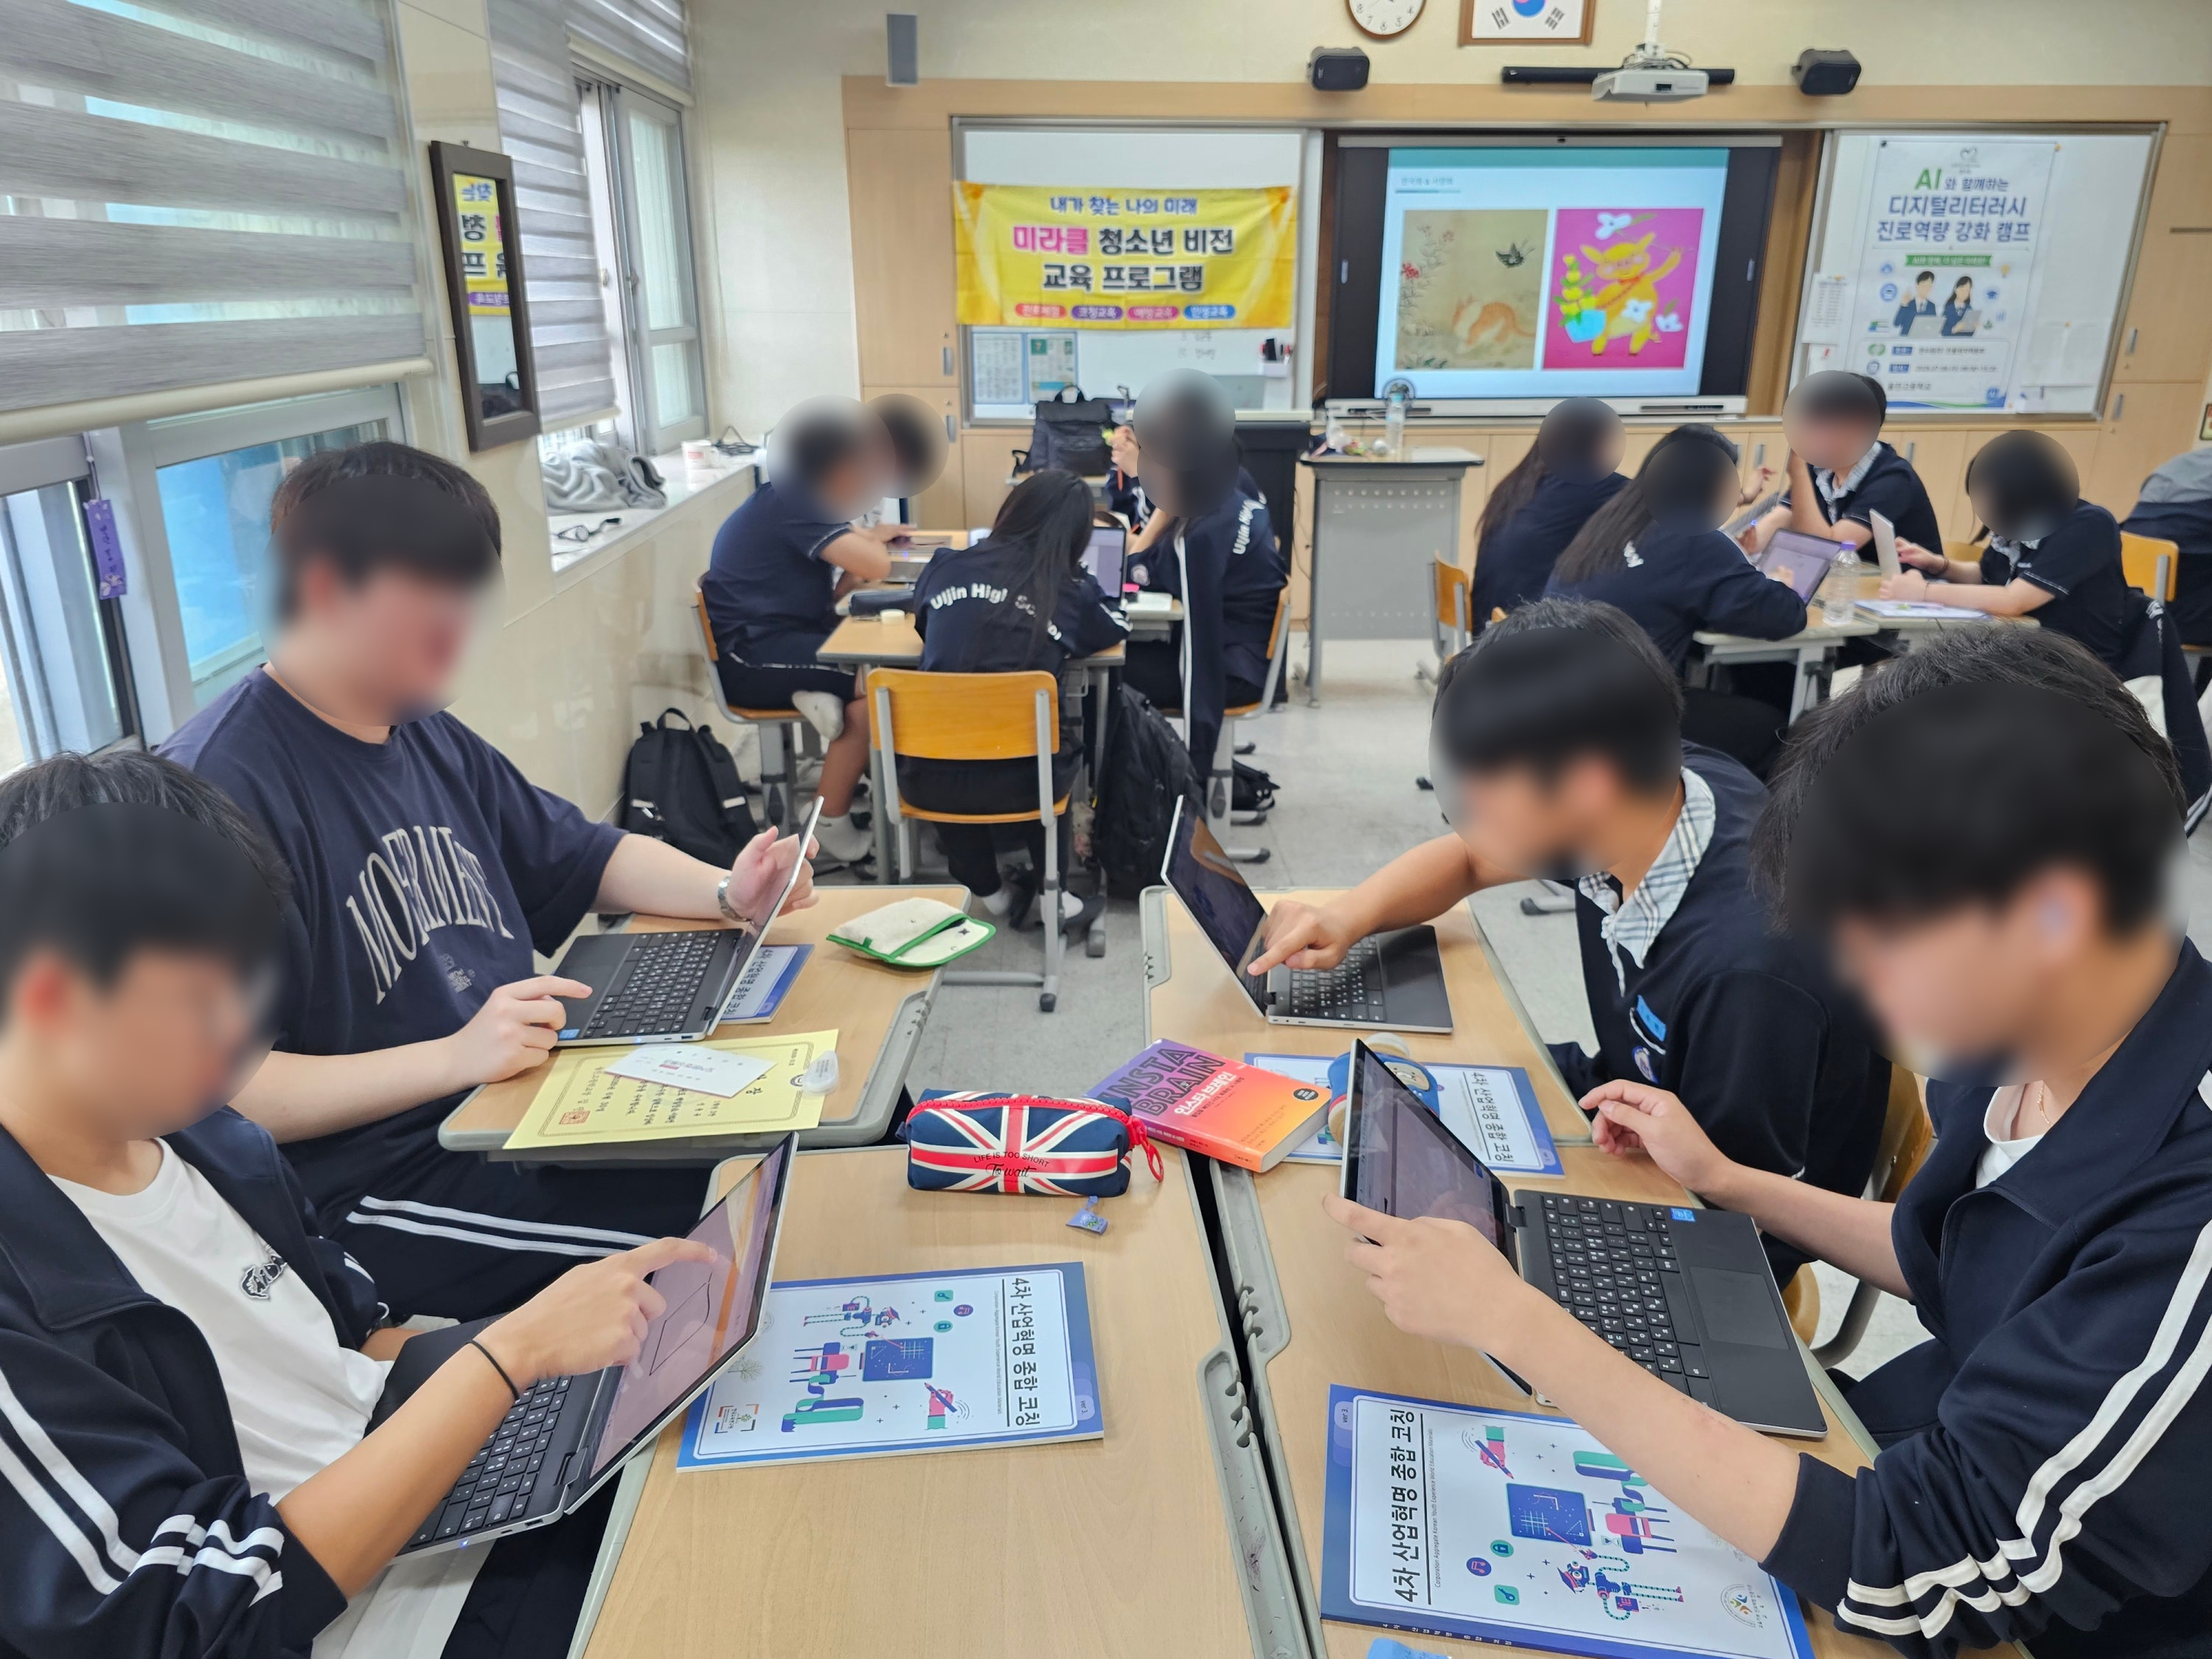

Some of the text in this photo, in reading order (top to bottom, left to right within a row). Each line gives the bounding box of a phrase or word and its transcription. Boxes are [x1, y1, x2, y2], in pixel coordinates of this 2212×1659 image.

[1914, 167, 1942, 190] AI
[1961, 177, 2009, 192] 함께하는
[1050, 196, 1198, 216] 내가 찾는 나의 미래
[1888, 195, 2027, 217] 디지털리터러시
[1014, 226, 1234, 255] 미라클 청소년 비전
[1877, 220, 2031, 243] 진로역량 강화 캠프
[1043, 263, 1204, 292] 교육 프로그램
[1132, 1054, 1226, 1116] BRAIN
[1174, 1091, 1211, 1116] 인스타
[1201, 1071, 1237, 1096] 브레인
[1474, 1088, 1500, 1120] 산업혁명
[1485, 1123, 1508, 1141] 종합
[973, 1153, 991, 1164] LIFE
[1022, 1152, 1050, 1167] SHORT
[1494, 1142, 1514, 1162] 코칭
[985, 1163, 1037, 1178] To wait
[1010, 1278, 1040, 1427] 4차 산업혁명 종합 코칭
[1390, 1408, 1420, 1603] 4차 산업혁명 종합 코칭
